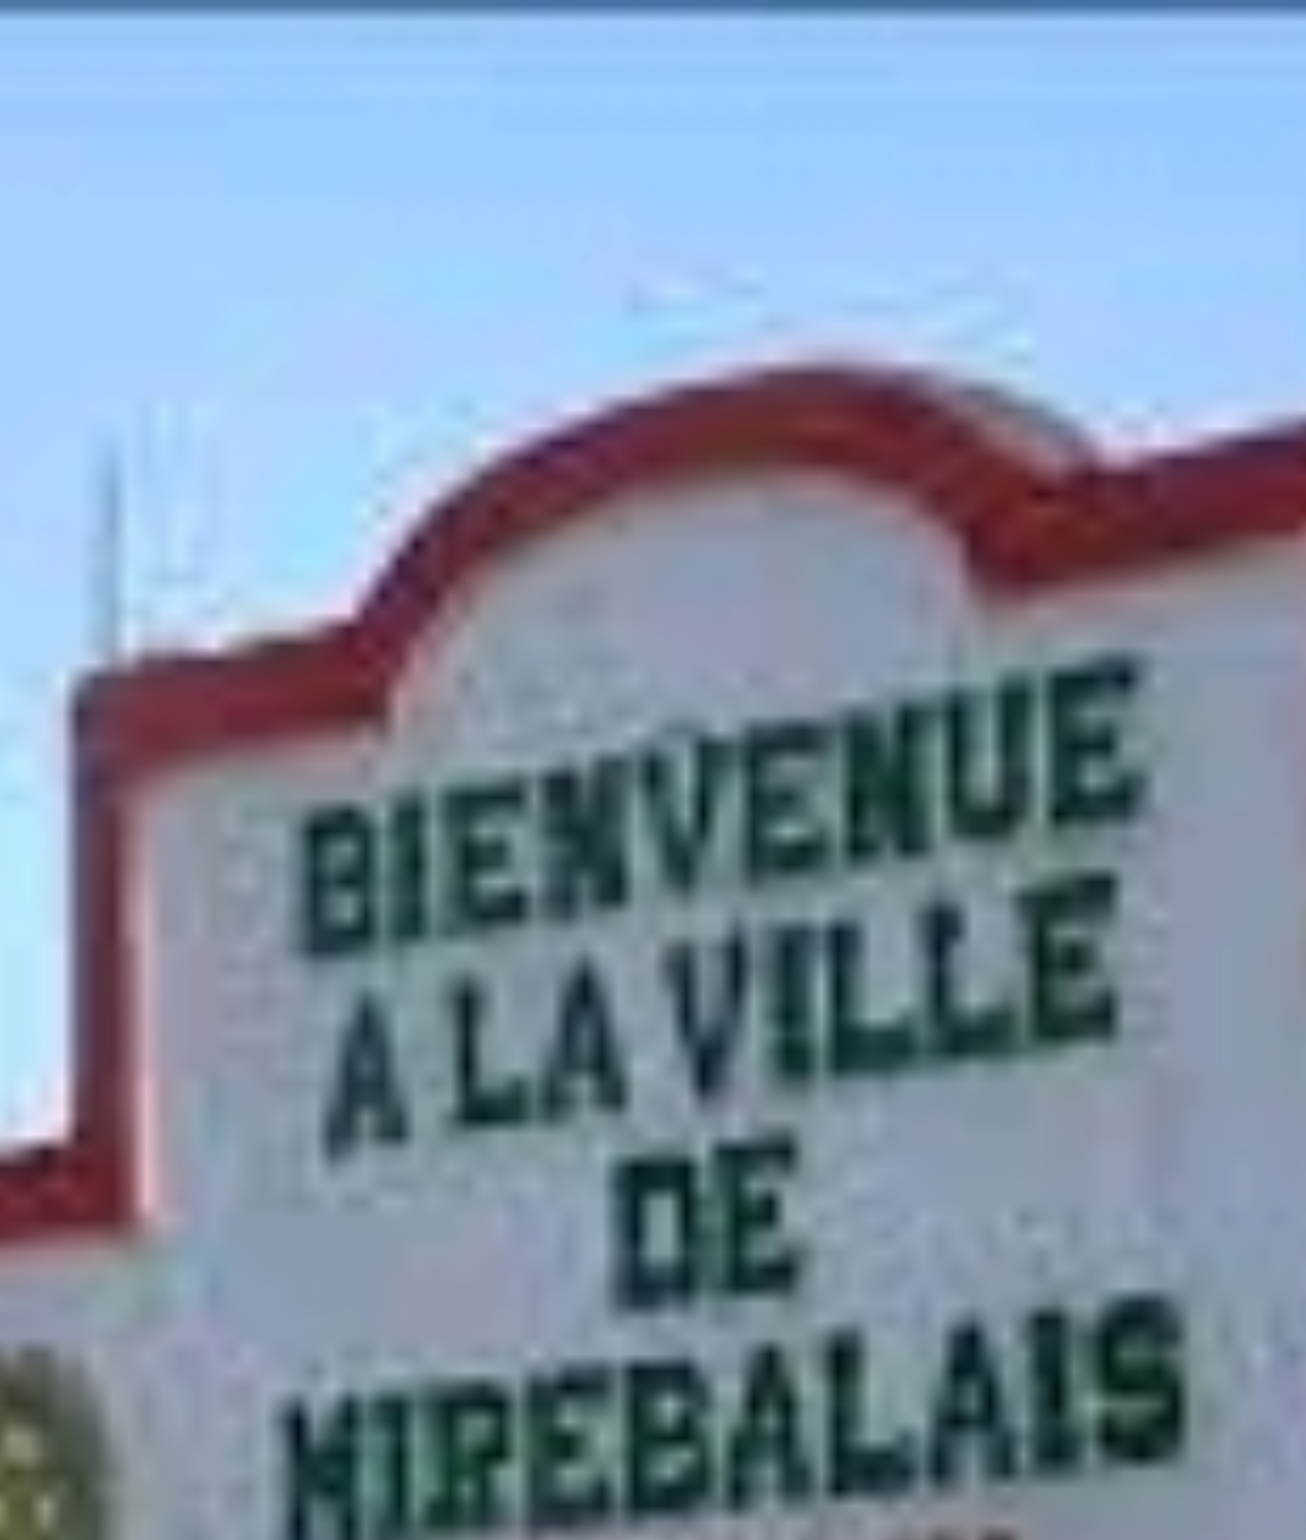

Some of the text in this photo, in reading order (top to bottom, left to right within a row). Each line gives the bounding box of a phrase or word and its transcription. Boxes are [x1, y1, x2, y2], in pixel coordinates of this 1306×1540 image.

[298, 655, 1148, 960] BIENVENUE
[322, 874, 1120, 1164] A LA VILLE
[611, 1134, 802, 1310] DE
